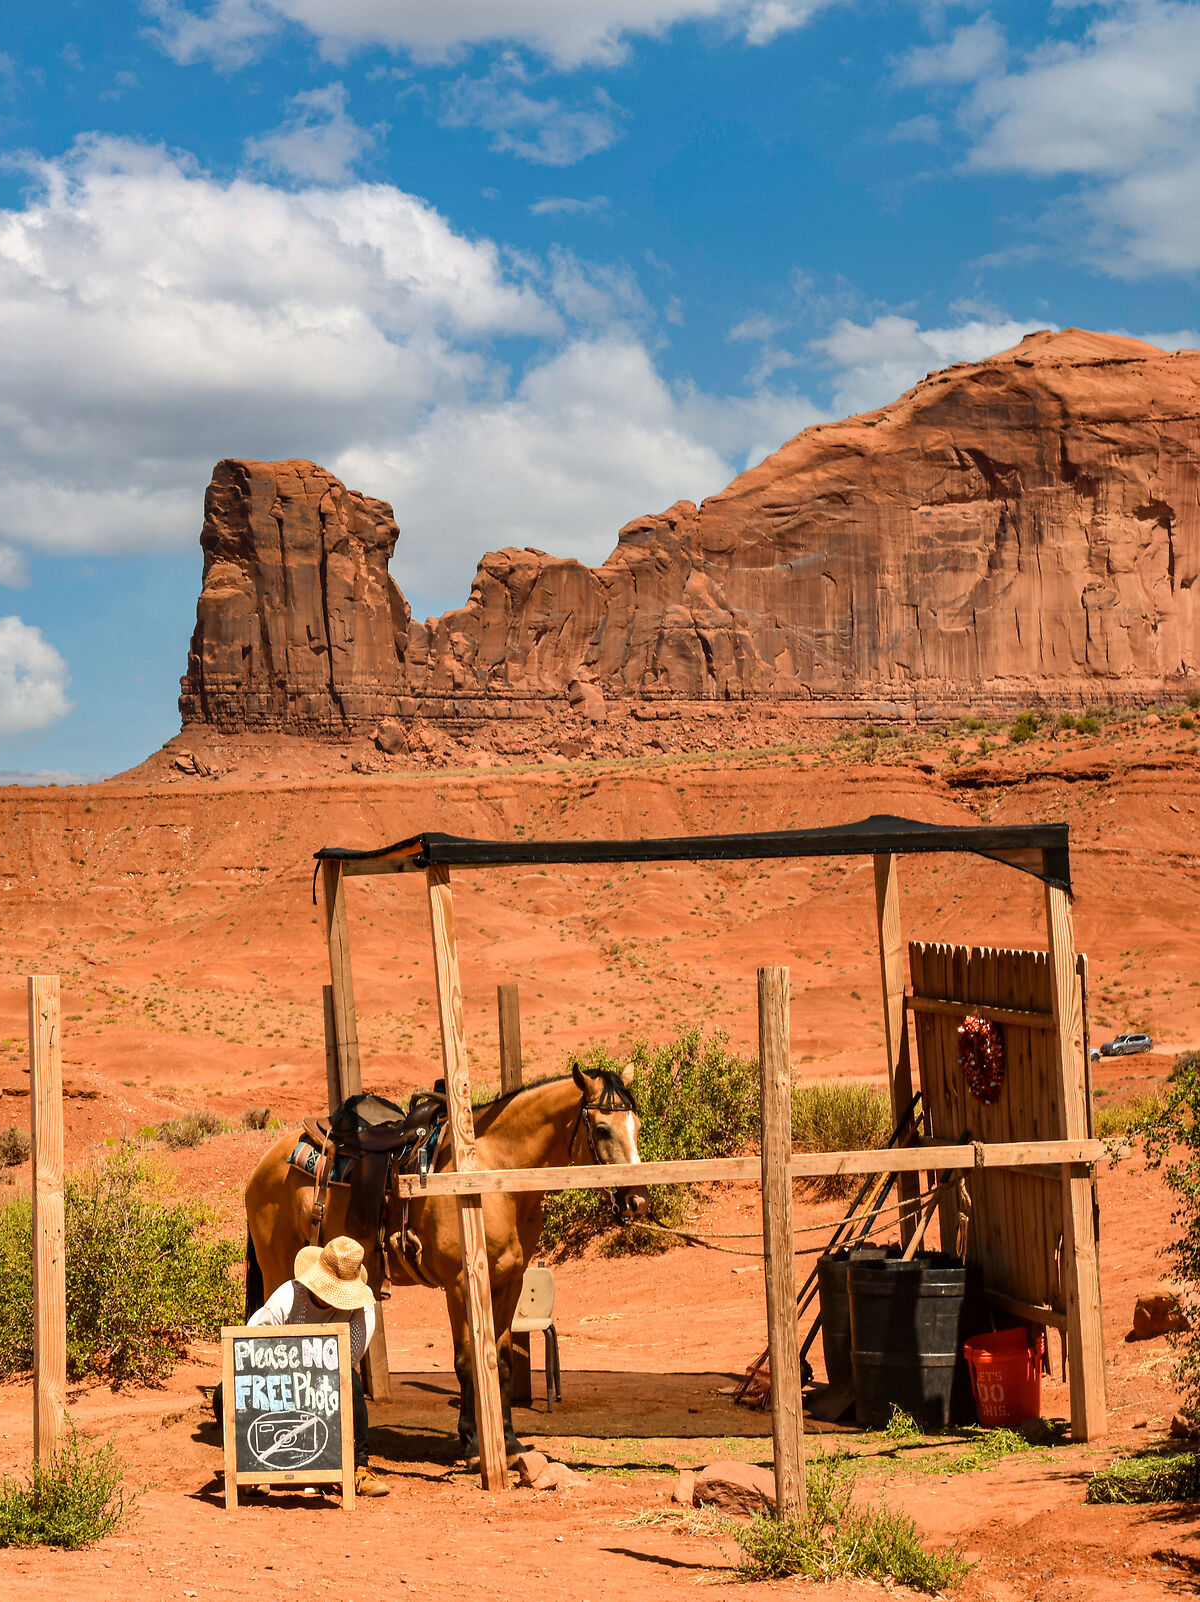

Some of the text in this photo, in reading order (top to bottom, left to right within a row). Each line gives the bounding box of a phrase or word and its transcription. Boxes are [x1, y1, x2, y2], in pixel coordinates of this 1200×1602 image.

[234, 1338, 339, 1371] Please NO
[235, 1371, 339, 1415] FREE Photo
[976, 1383, 1004, 1402] DO
